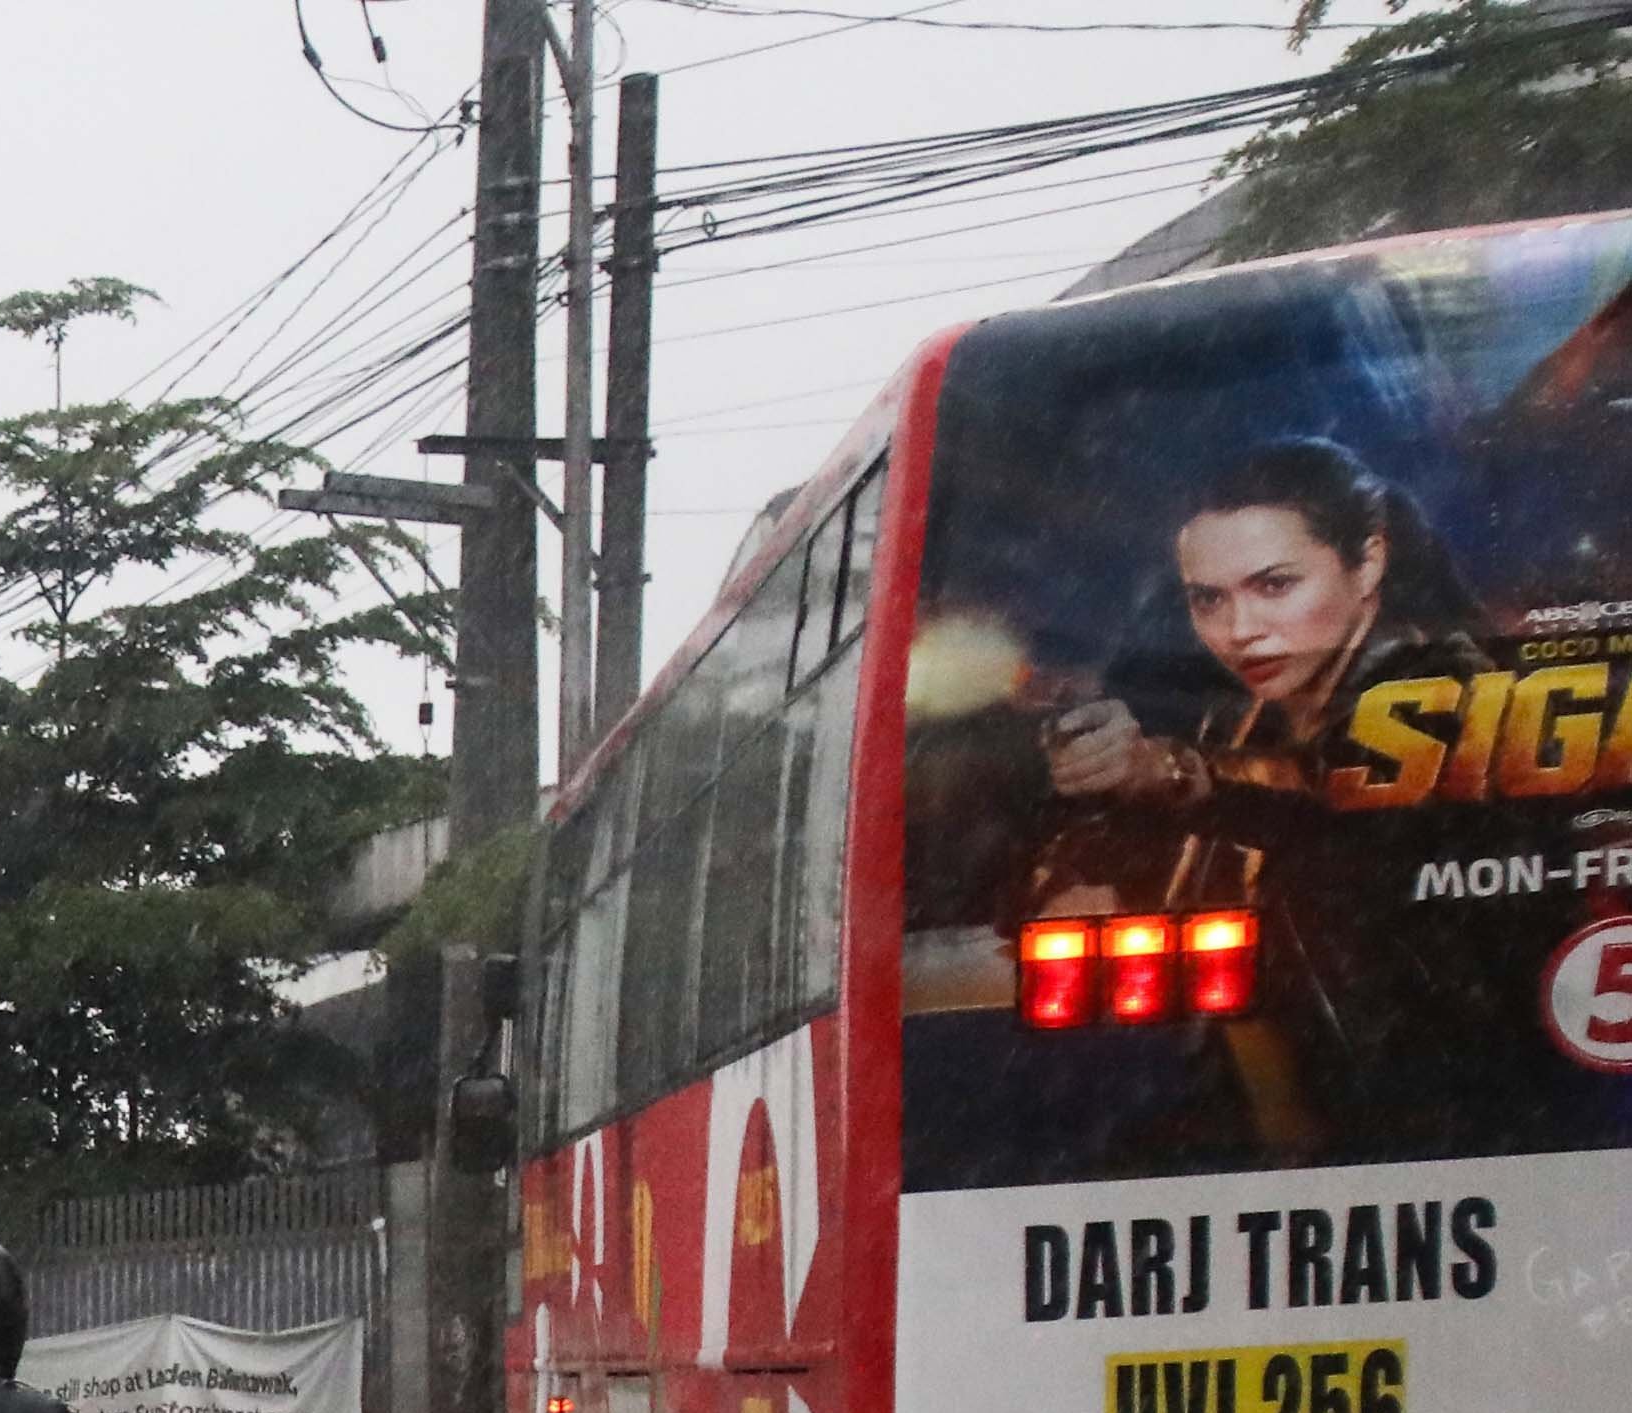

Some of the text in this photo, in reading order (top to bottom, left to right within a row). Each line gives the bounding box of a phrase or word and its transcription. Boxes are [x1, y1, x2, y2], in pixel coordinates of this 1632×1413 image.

[1322, 661, 1632, 811] SIG
[1023, 1196, 1498, 1323] DARJ TRANS
[83, 1376, 121, 1399] shop
[125, 1371, 144, 1393] at
